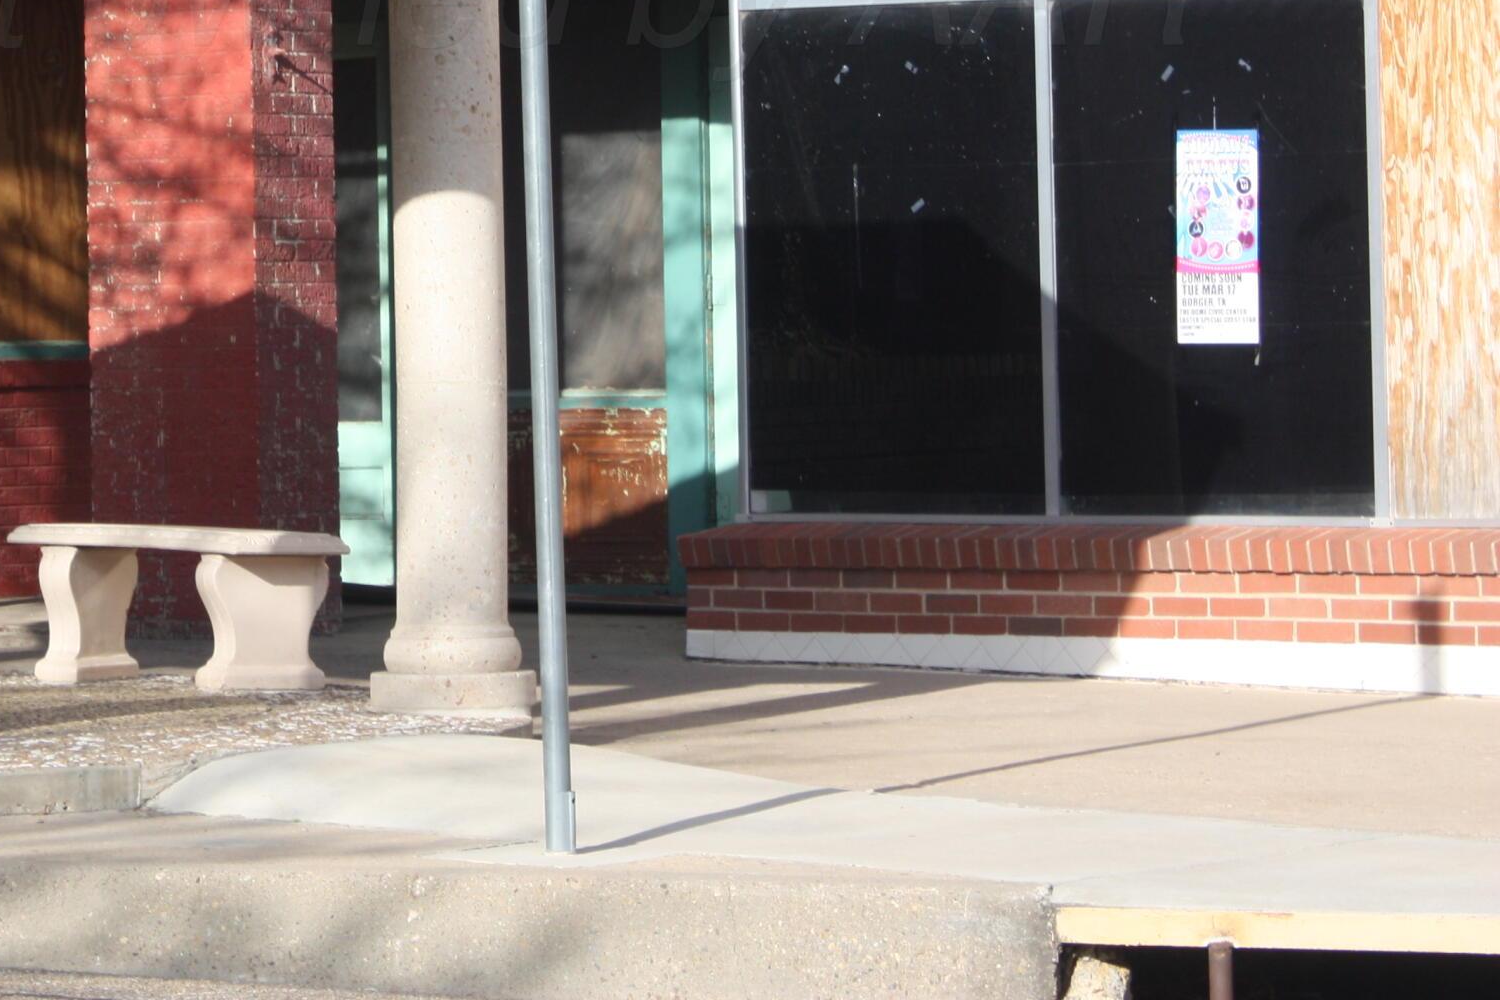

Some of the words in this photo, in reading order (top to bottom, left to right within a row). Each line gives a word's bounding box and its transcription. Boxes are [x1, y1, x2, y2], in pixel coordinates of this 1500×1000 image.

[1181, 272, 1216, 283] COMING
[1219, 272, 1242, 283] SOON
[1182, 284, 1199, 296] TUE
[1202, 284, 1224, 296] MAR
[1227, 284, 1236, 295] 17
